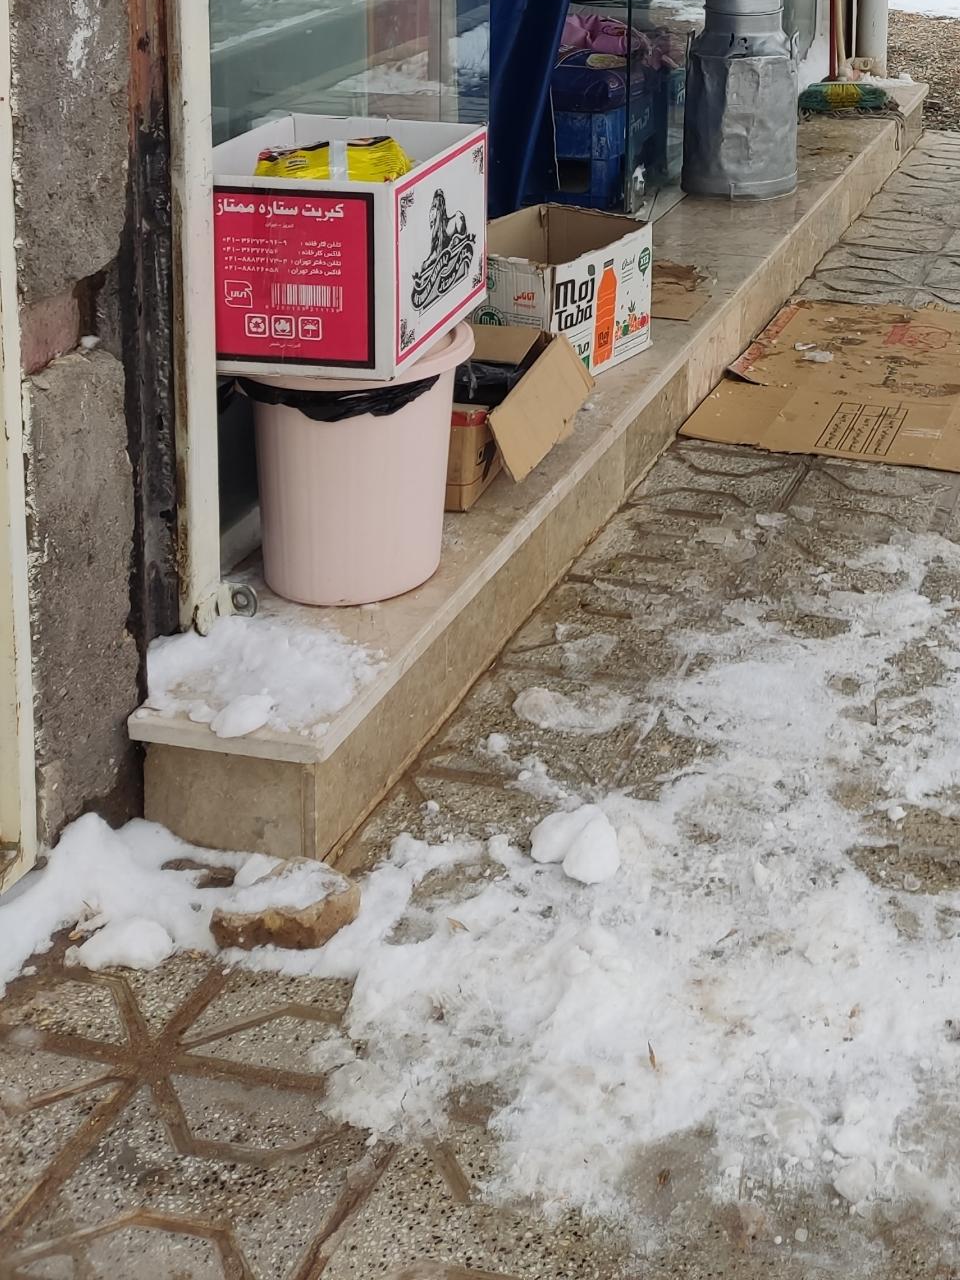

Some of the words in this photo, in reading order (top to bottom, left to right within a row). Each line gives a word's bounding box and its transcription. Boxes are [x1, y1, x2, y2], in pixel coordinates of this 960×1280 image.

[216, 198, 255, 216] ممتاز
[258, 200, 299, 218] ستاره
[301, 203, 344, 222] کبریت
